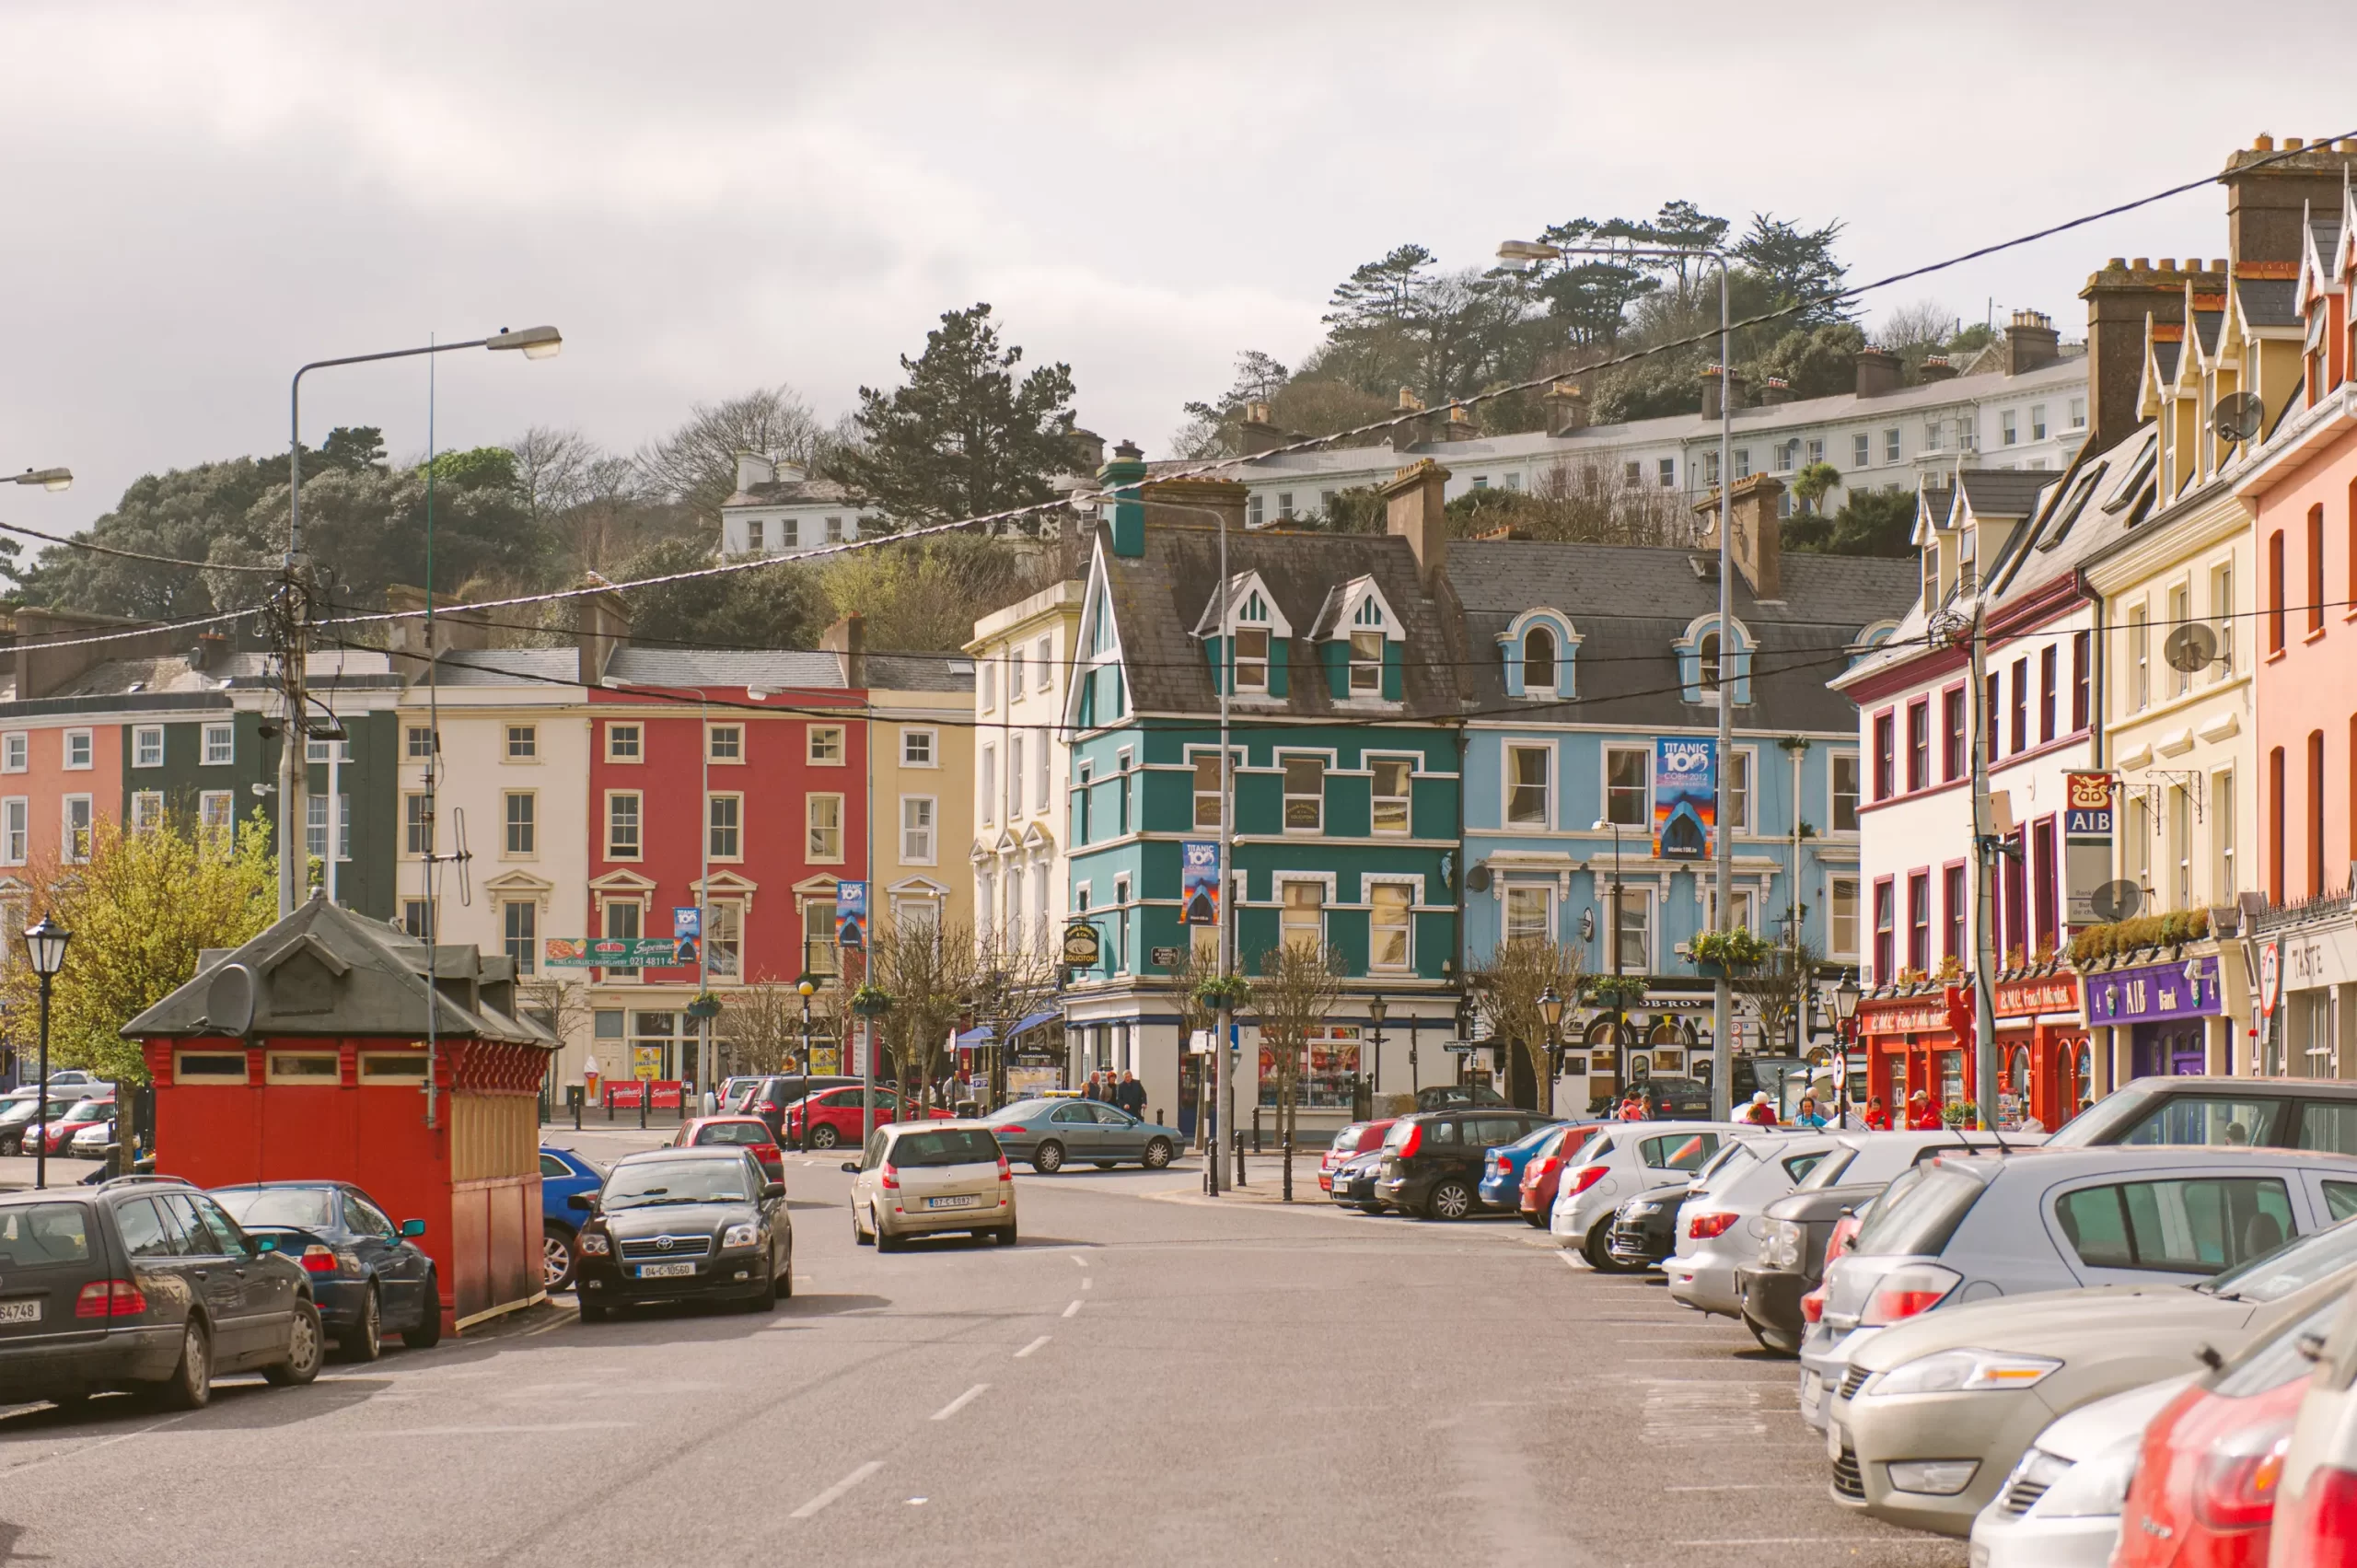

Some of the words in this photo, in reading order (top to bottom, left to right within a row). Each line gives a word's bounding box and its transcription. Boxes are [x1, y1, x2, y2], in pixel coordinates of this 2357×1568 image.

[1664, 742, 1709, 754] TITANIC
[1664, 752, 1709, 772] 100
[1664, 772, 1689, 781] COBH
[1689, 772, 1708, 782] 2012
[2072, 812, 2110, 830] AIB
[1187, 844, 1214, 853] TITANIC
[629, 957, 644, 966] 021
[645, 957, 665, 966] 4811
[1064, 954, 1098, 962] SOLICITORS
[2292, 945, 2323, 979] TASTE
[2024, 986, 2042, 1007] Food
[2043, 983, 2069, 1005] Market
[2126, 980, 2147, 1015] AIB
[2158, 986, 2177, 1011] Bank
[1639, 1000, 1702, 1008] OB-ROY
[1897, 1010, 1917, 1028] Food
[645, 1264, 691, 1277] 04-C-10560
